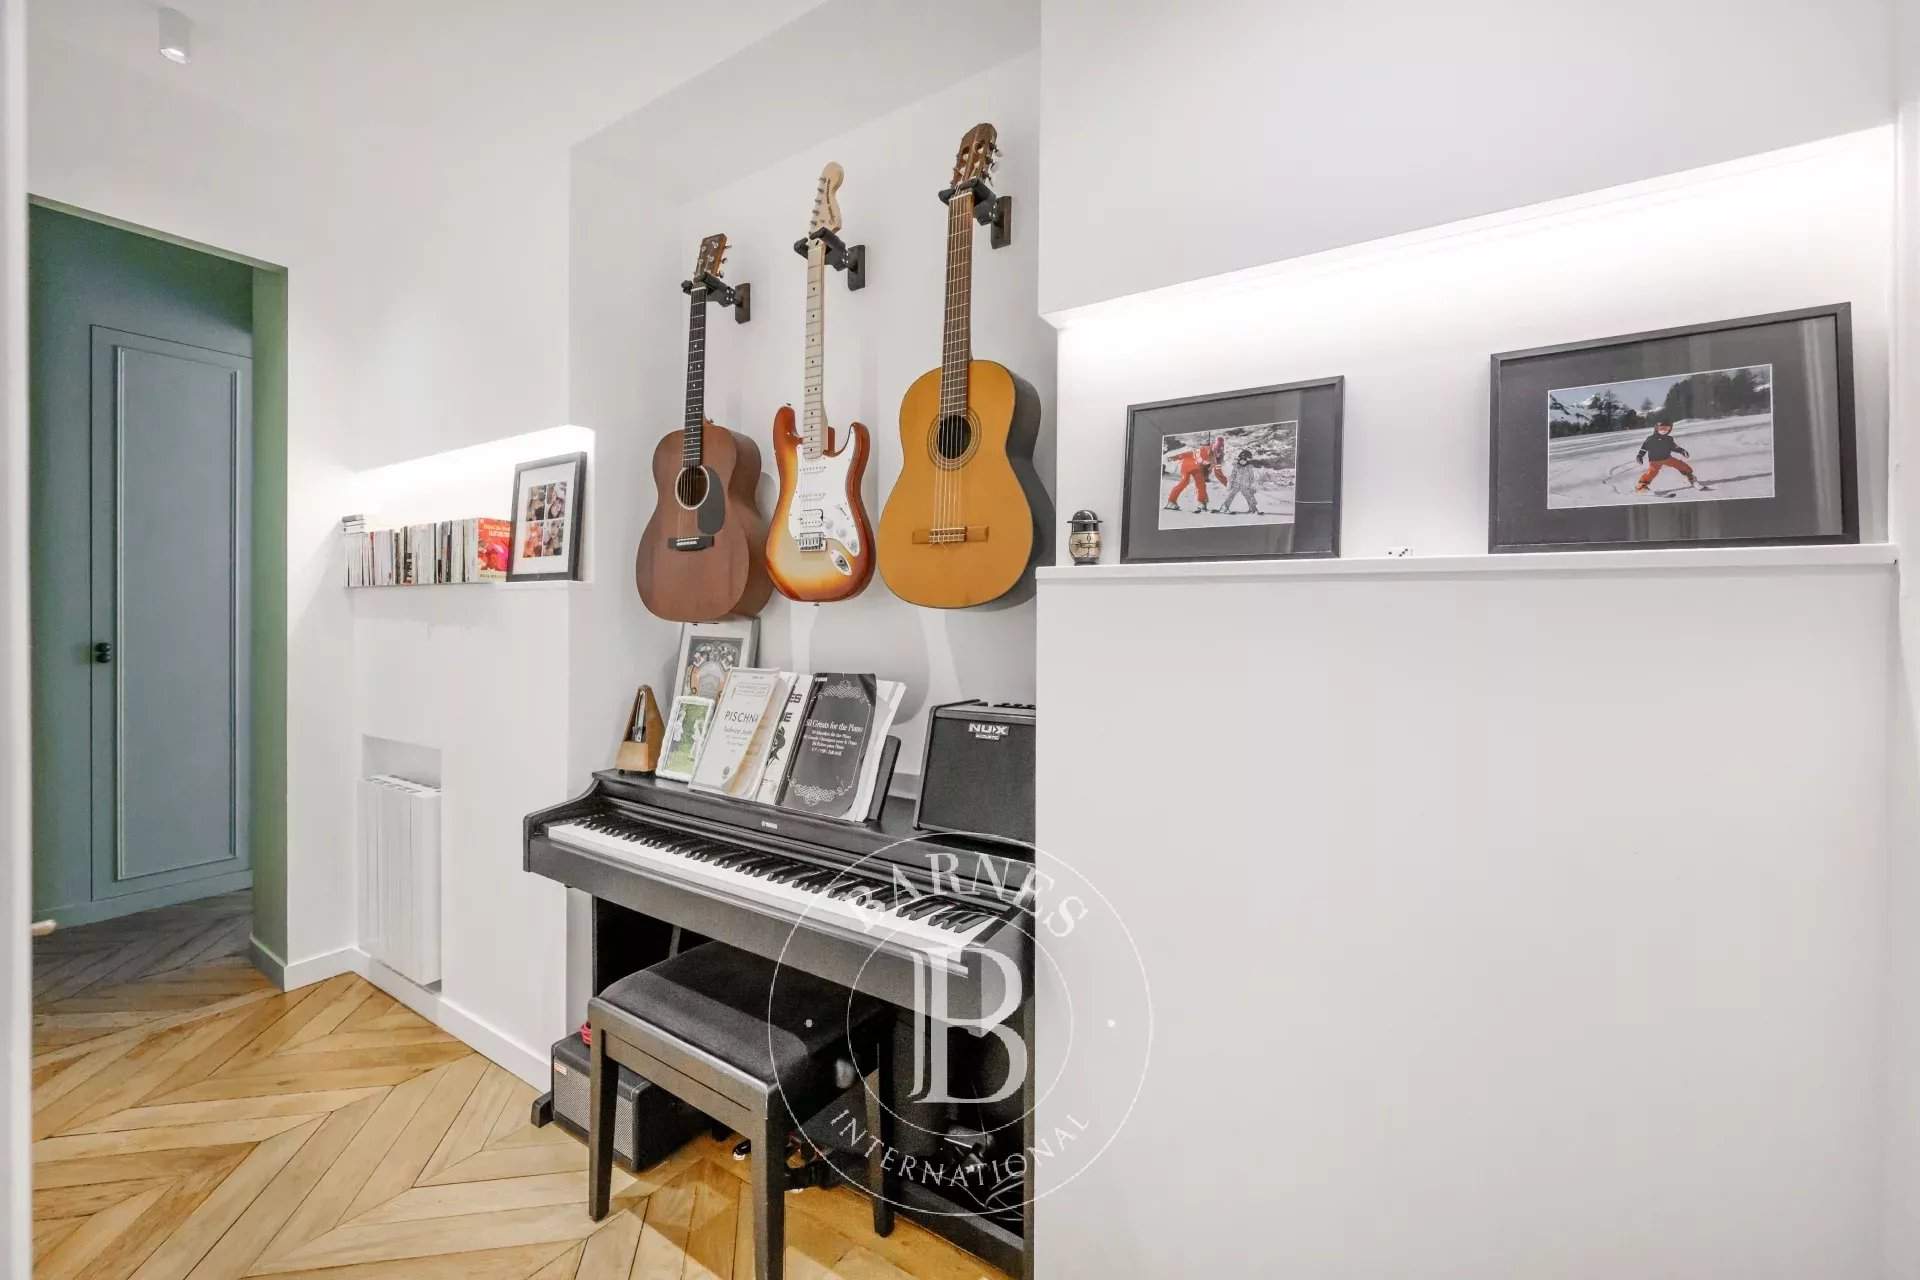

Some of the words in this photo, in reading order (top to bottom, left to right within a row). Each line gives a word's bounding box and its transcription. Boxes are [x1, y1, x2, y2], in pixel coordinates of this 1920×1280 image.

[830, 721, 839, 729] for
[839, 722, 848, 731] the
[968, 723, 1009, 735] NUX
